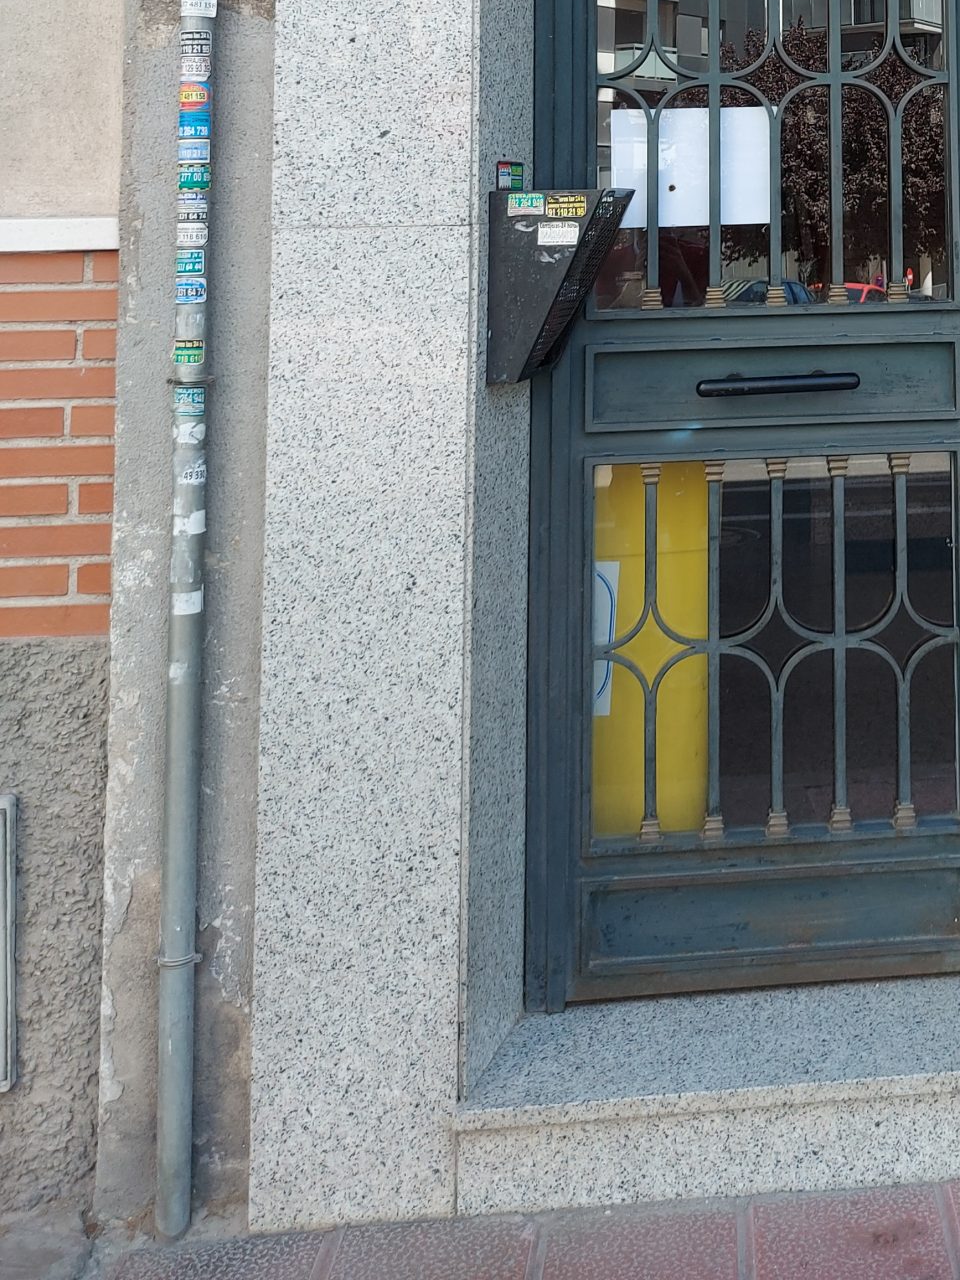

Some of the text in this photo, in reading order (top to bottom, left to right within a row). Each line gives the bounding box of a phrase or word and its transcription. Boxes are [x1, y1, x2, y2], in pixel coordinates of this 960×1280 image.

[193, 173, 202, 182] 00
[548, 208, 556, 217] 91
[568, 207, 576, 216] 21
[576, 206, 585, 216] 95
[187, 288, 196, 296] 64
